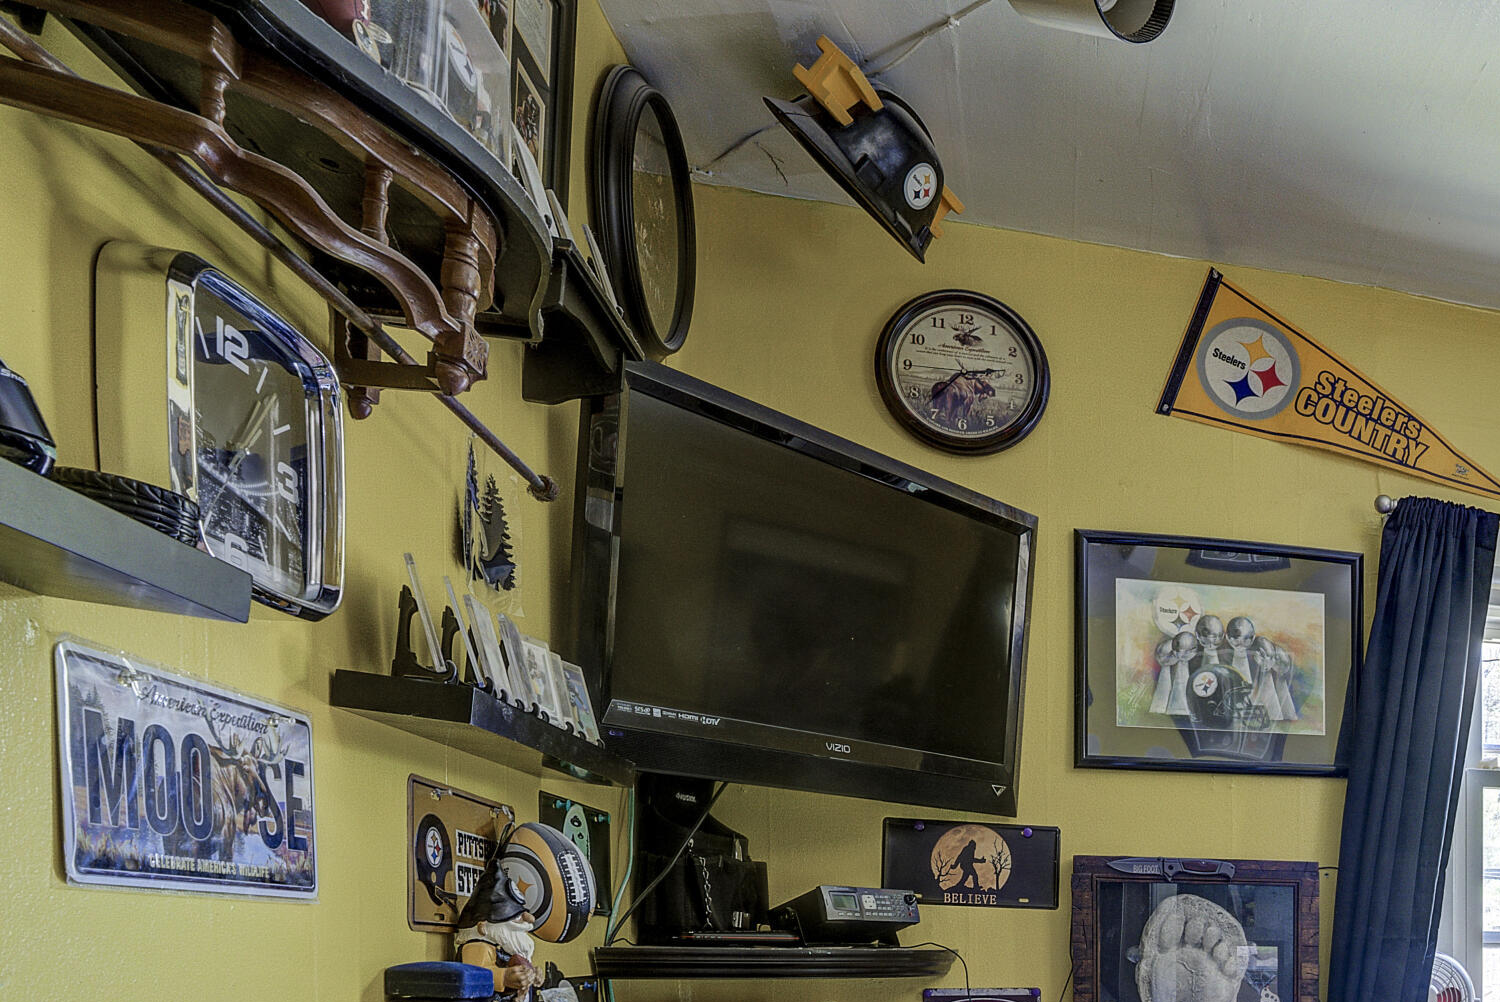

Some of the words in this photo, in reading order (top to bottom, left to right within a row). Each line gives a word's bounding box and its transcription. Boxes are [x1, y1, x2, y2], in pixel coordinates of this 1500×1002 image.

[931, 317, 946, 329] 11
[958, 313, 974, 326] 12
[989, 325, 998, 336] 1
[216, 314, 249, 376] 12
[910, 333, 926, 346] 10
[1008, 346, 1018, 358] 2
[903, 359, 913, 371] 9
[1211, 347, 1247, 371] Steelers
[1015, 373, 1024, 385] 3
[909, 386, 920, 399] 8
[1315, 371, 1421, 440] Steelers
[931, 408, 940, 420] 7
[985, 414, 995, 427] 5
[957, 418, 968, 430] 6
[1295, 387, 1430, 468] COUNTRY
[276, 461, 300, 504] 3
[139, 684, 207, 719] American
[208, 700, 270, 735] Expedition
[824, 741, 851, 754] VIZIO
[149, 853, 196, 872] CELEBRATE
[196, 857, 237, 876] AMERICA'S
[238, 863, 270, 878] WILDLIFE
[1132, 864, 1144, 873] BIG
[1143, 865, 1160, 874] FOOT
[942, 892, 998, 905] BELIEVE
